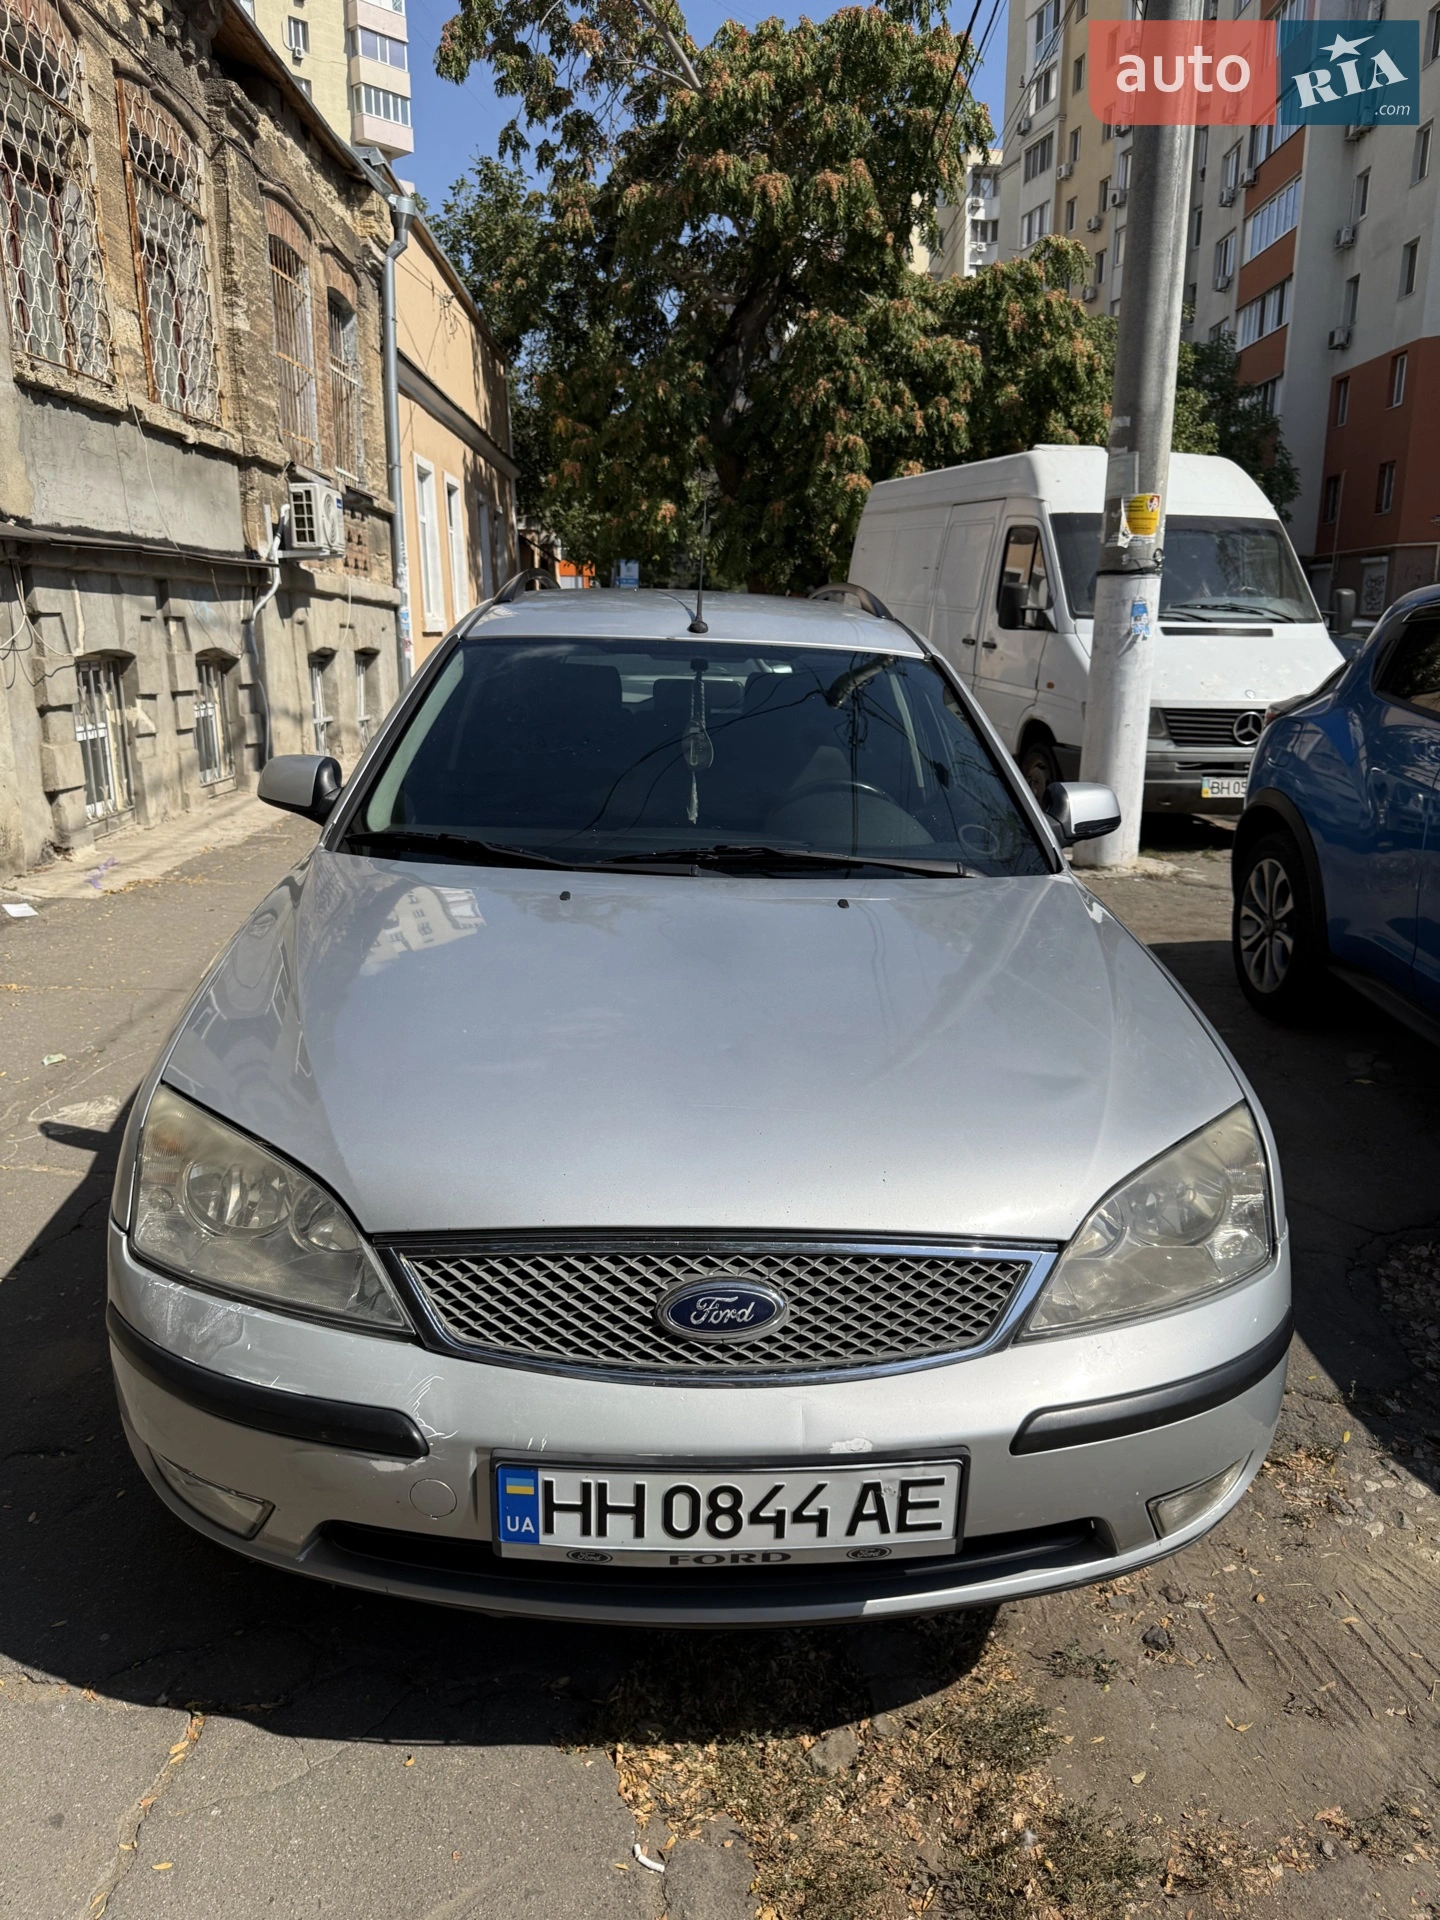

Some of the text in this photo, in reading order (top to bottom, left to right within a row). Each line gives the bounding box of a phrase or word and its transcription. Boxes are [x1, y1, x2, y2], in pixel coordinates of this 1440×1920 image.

[1210, 781, 1230, 795] BH
[690, 1296, 755, 1325] Ford
[543, 1477, 946, 1539] HH 0844 AE
[506, 1515, 535, 1534] UA
[669, 1551, 792, 1566] FORD
